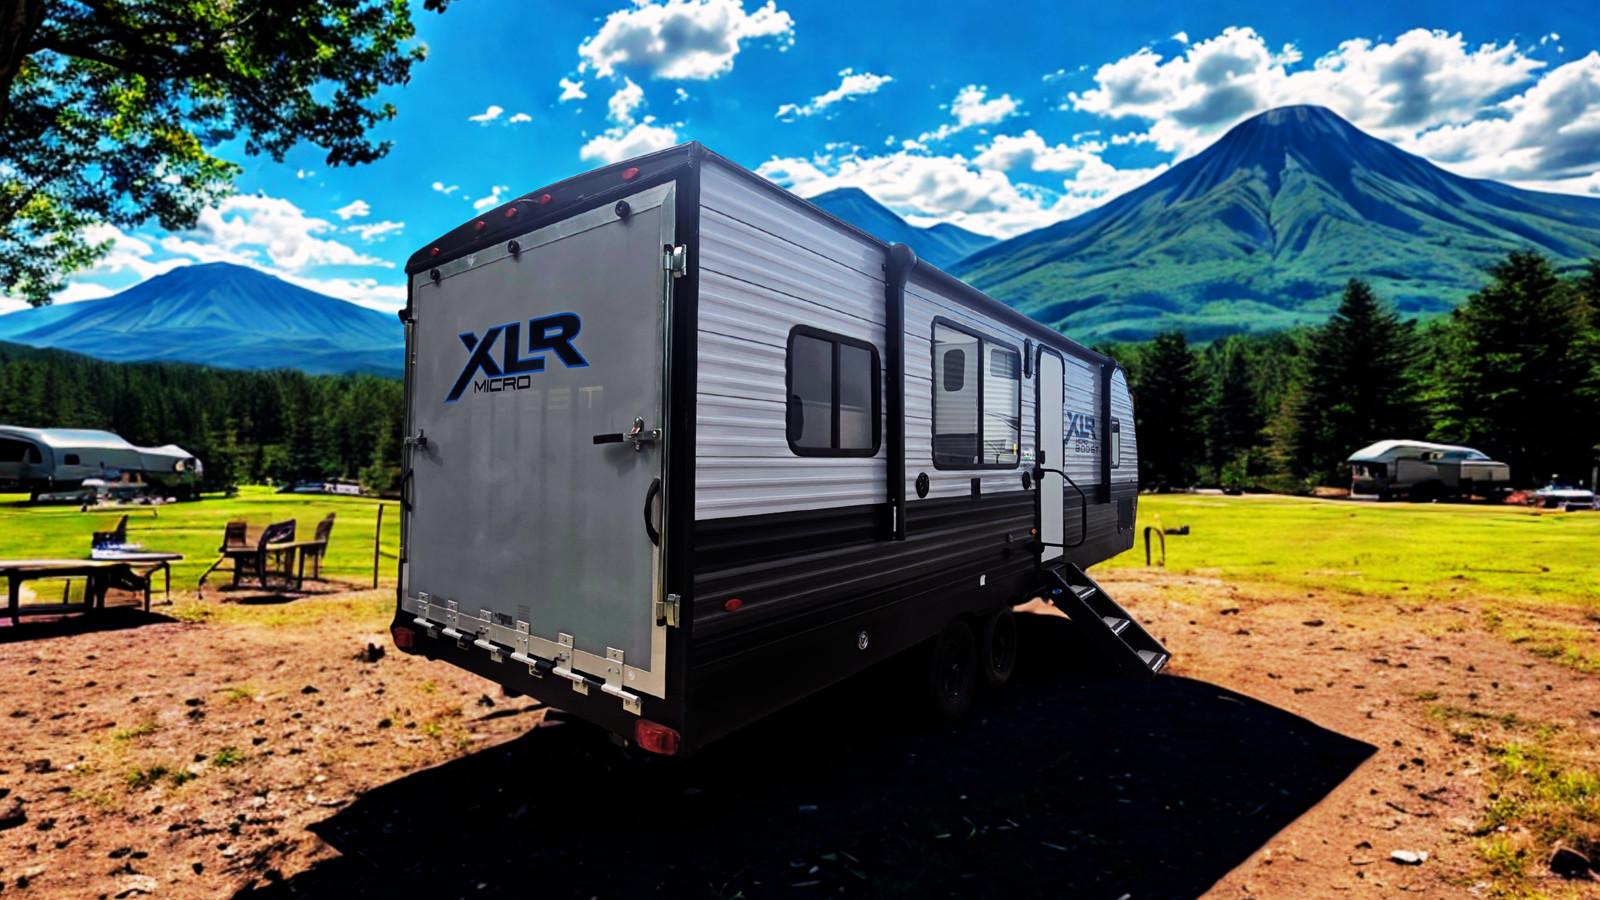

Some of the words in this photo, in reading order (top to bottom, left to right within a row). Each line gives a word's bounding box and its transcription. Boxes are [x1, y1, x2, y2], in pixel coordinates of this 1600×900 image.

[443, 311, 590, 403] XLR
[474, 375, 531, 394] MICRO
[1064, 412, 1097, 445] XLR
